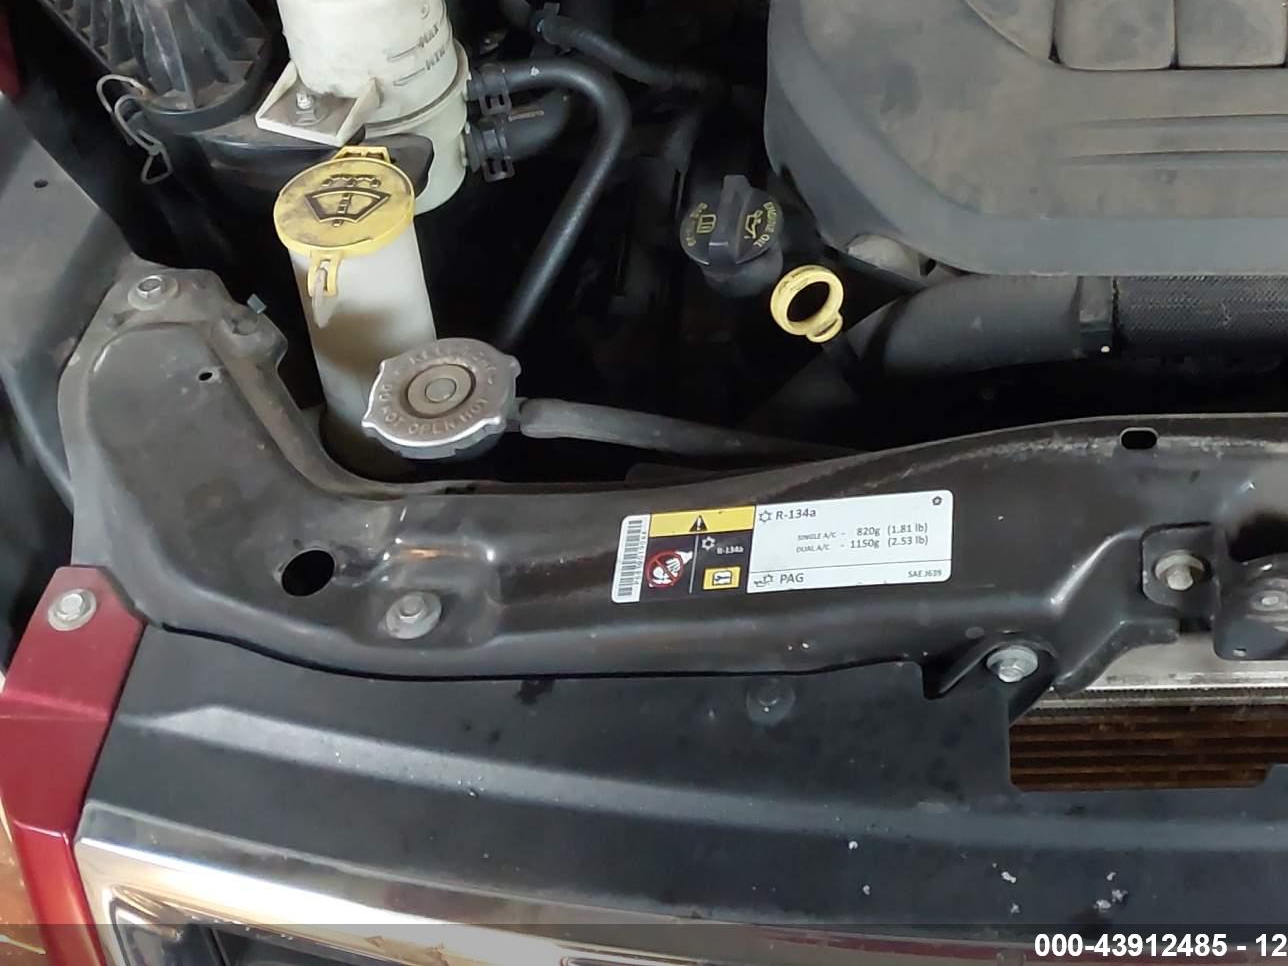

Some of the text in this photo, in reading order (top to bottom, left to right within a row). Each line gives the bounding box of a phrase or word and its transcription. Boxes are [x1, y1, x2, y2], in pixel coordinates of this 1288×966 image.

[753, 233, 770, 248] OIL
[775, 508, 817, 520] R-134a
[856, 527, 881, 537] 820g
[887, 524, 912, 536] (1.81
[915, 522, 928, 534] lb)
[796, 545, 815, 553] DUAL
[850, 539, 880, 549] 1150g
[887, 536, 913, 548] (2.53
[915, 535, 928, 546] lb)
[780, 573, 804, 584] PAG
